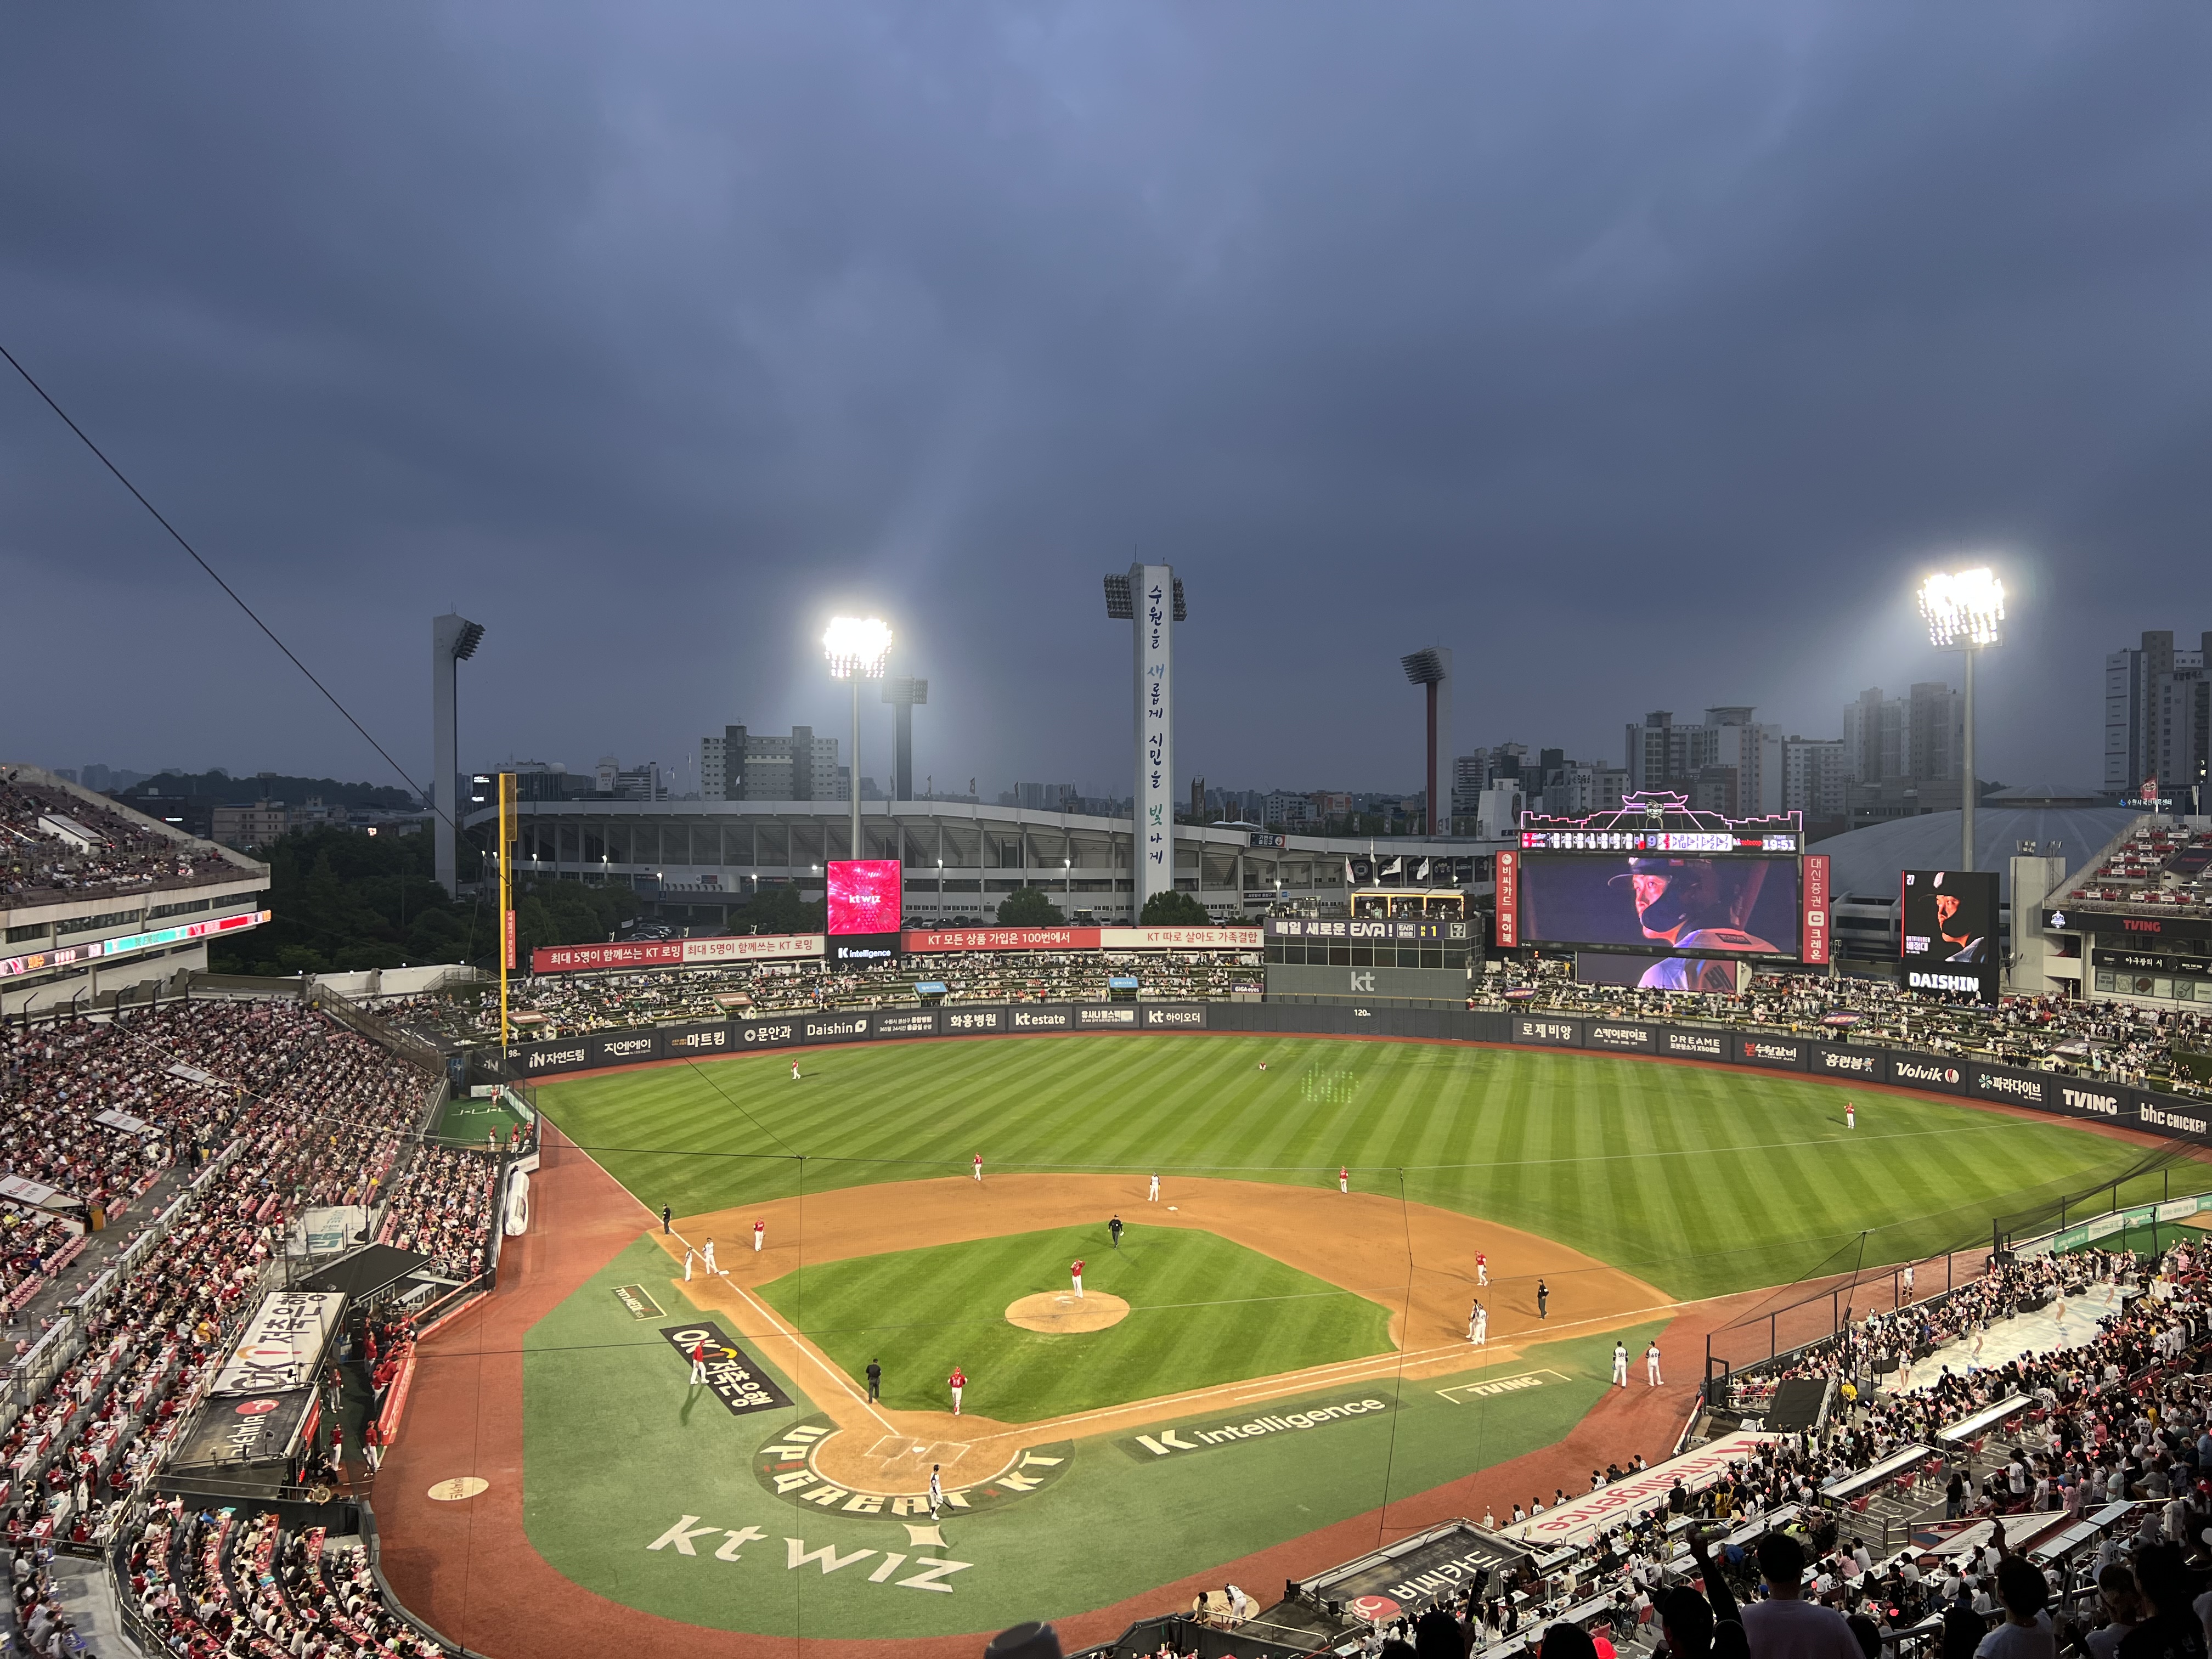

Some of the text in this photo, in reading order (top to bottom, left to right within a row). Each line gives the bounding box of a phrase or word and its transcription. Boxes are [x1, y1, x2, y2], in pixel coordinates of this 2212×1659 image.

[1147, 585, 1164, 864] 수원을 새롭게 시민을 빛나게
[1763, 839, 1796, 851] 19:51
[1810, 858, 1821, 907] 대신증권
[1906, 874, 1915, 885] 27
[849, 895, 860, 904] kt
[1502, 866, 1513, 943] 비씨카드 페이북
[1276, 922, 1301, 935] 매일
[1306, 922, 1346, 936] 새로운
[1431, 926, 1436, 937] 1
[2123, 919, 2160, 932] TVING
[928, 932, 1070, 946] KT 모든 상품 가입은 100번에서
[1148, 932, 1257, 943] KT 따로 살아도 가족결합
[1810, 929, 1821, 960] 크레온
[551, 945, 680, 964] 최대 5명이 함께쓰는 KT 로밍
[687, 939, 812, 956] 최대 5명이 함께쓰는 KT 로밍
[838, 947, 891, 959] K intelligence
[1906, 942, 1928, 952] 배정대
[2125, 956, 2163, 968] 야구광의 시
[1351, 972, 1375, 992] kt
[1910, 972, 1979, 992] DAISHIN
[911, 1015, 932, 1024] 종합병원
[950, 1013, 996, 1028] 화홍병원
[1015, 1012, 1065, 1025] kt estate
[1149, 1011, 1200, 1023] kt 하이오더
[757, 1025, 792, 1041] 문안과
[807, 1022, 853, 1036] Daishin
[1522, 1023, 1572, 1040] 로제비앙
[1594, 1028, 1647, 1041] 스카이라이프
[687, 1031, 725, 1047] 마트킹
[1670, 1035, 1720, 1047] DREAME
[1671, 1042, 1696, 1051] 로봇청소기
[546, 1048, 584, 1064] 자연드림
[1743, 1042, 1796, 1058] 본수원갈비
[1896, 1062, 1943, 1081] Volvik
[1993, 1076, 2042, 1097] 파라다이브
[2063, 1088, 2118, 1114] TVING
[2142, 1103, 2207, 1135] bhc CHICKEN
[258, 1293, 328, 1344] 저축은행
[707, 1359, 774, 1408] 저축은행
[1466, 1375, 1543, 1396] TVING
[1135, 1396, 1386, 1455] K intelligence
[773, 1469, 971, 1517] GREAT
[996, 1451, 1065, 1491] KT
[1537, 1458, 1718, 1531] intelligence
[646, 1515, 974, 1593] kt wiz
